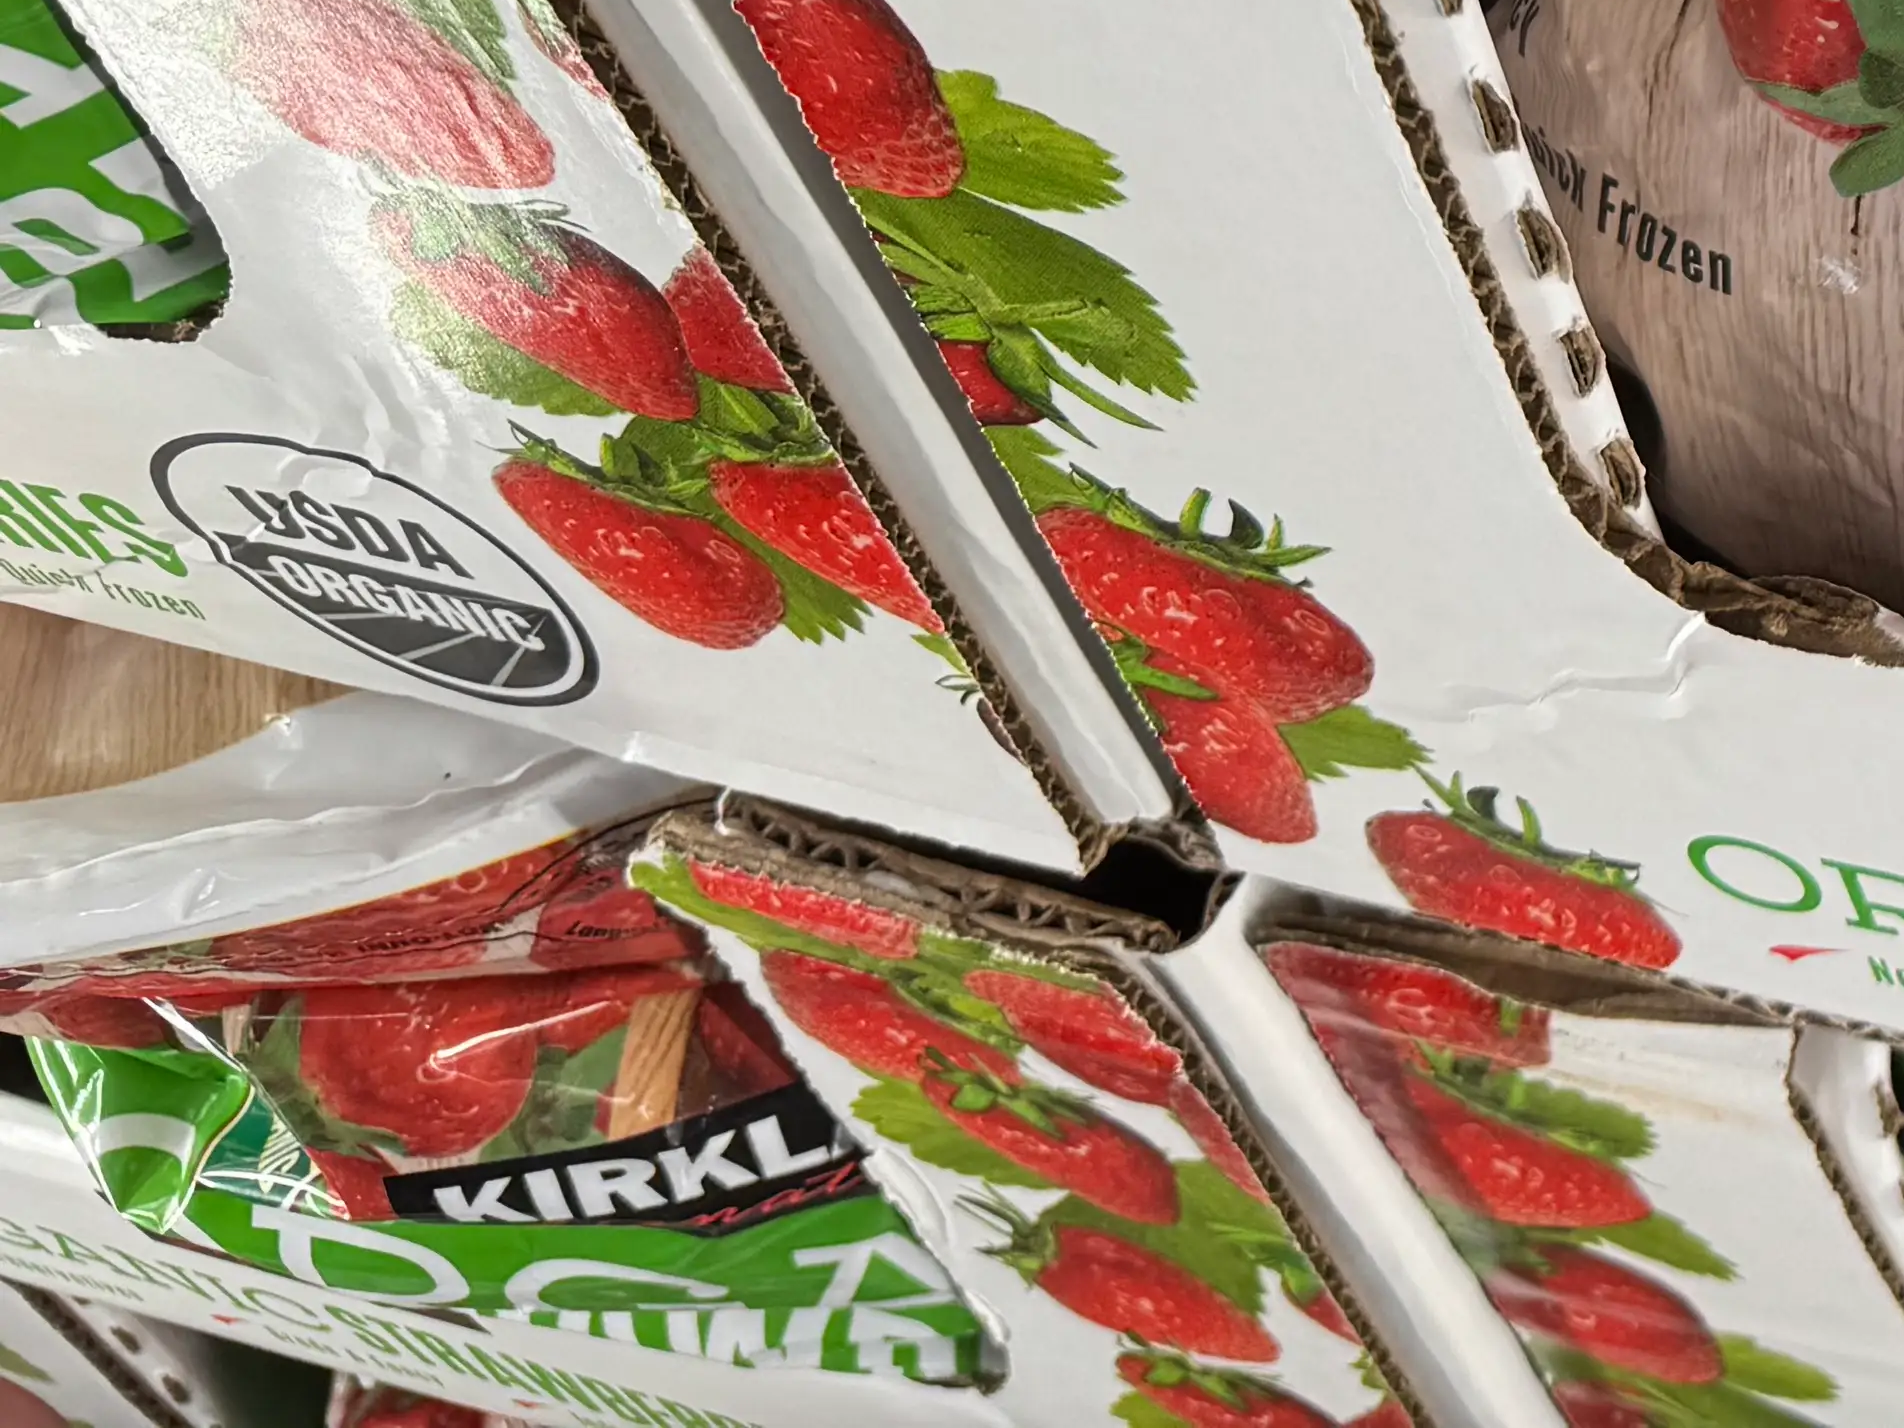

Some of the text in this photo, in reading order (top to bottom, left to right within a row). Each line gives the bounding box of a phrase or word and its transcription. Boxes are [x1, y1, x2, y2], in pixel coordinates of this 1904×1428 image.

[1521, 121, 1733, 296] uick Frozen
[224, 484, 476, 581] USDA
[265, 552, 546, 654] ORGANIC
[432, 1113, 830, 1223] KIRKL
